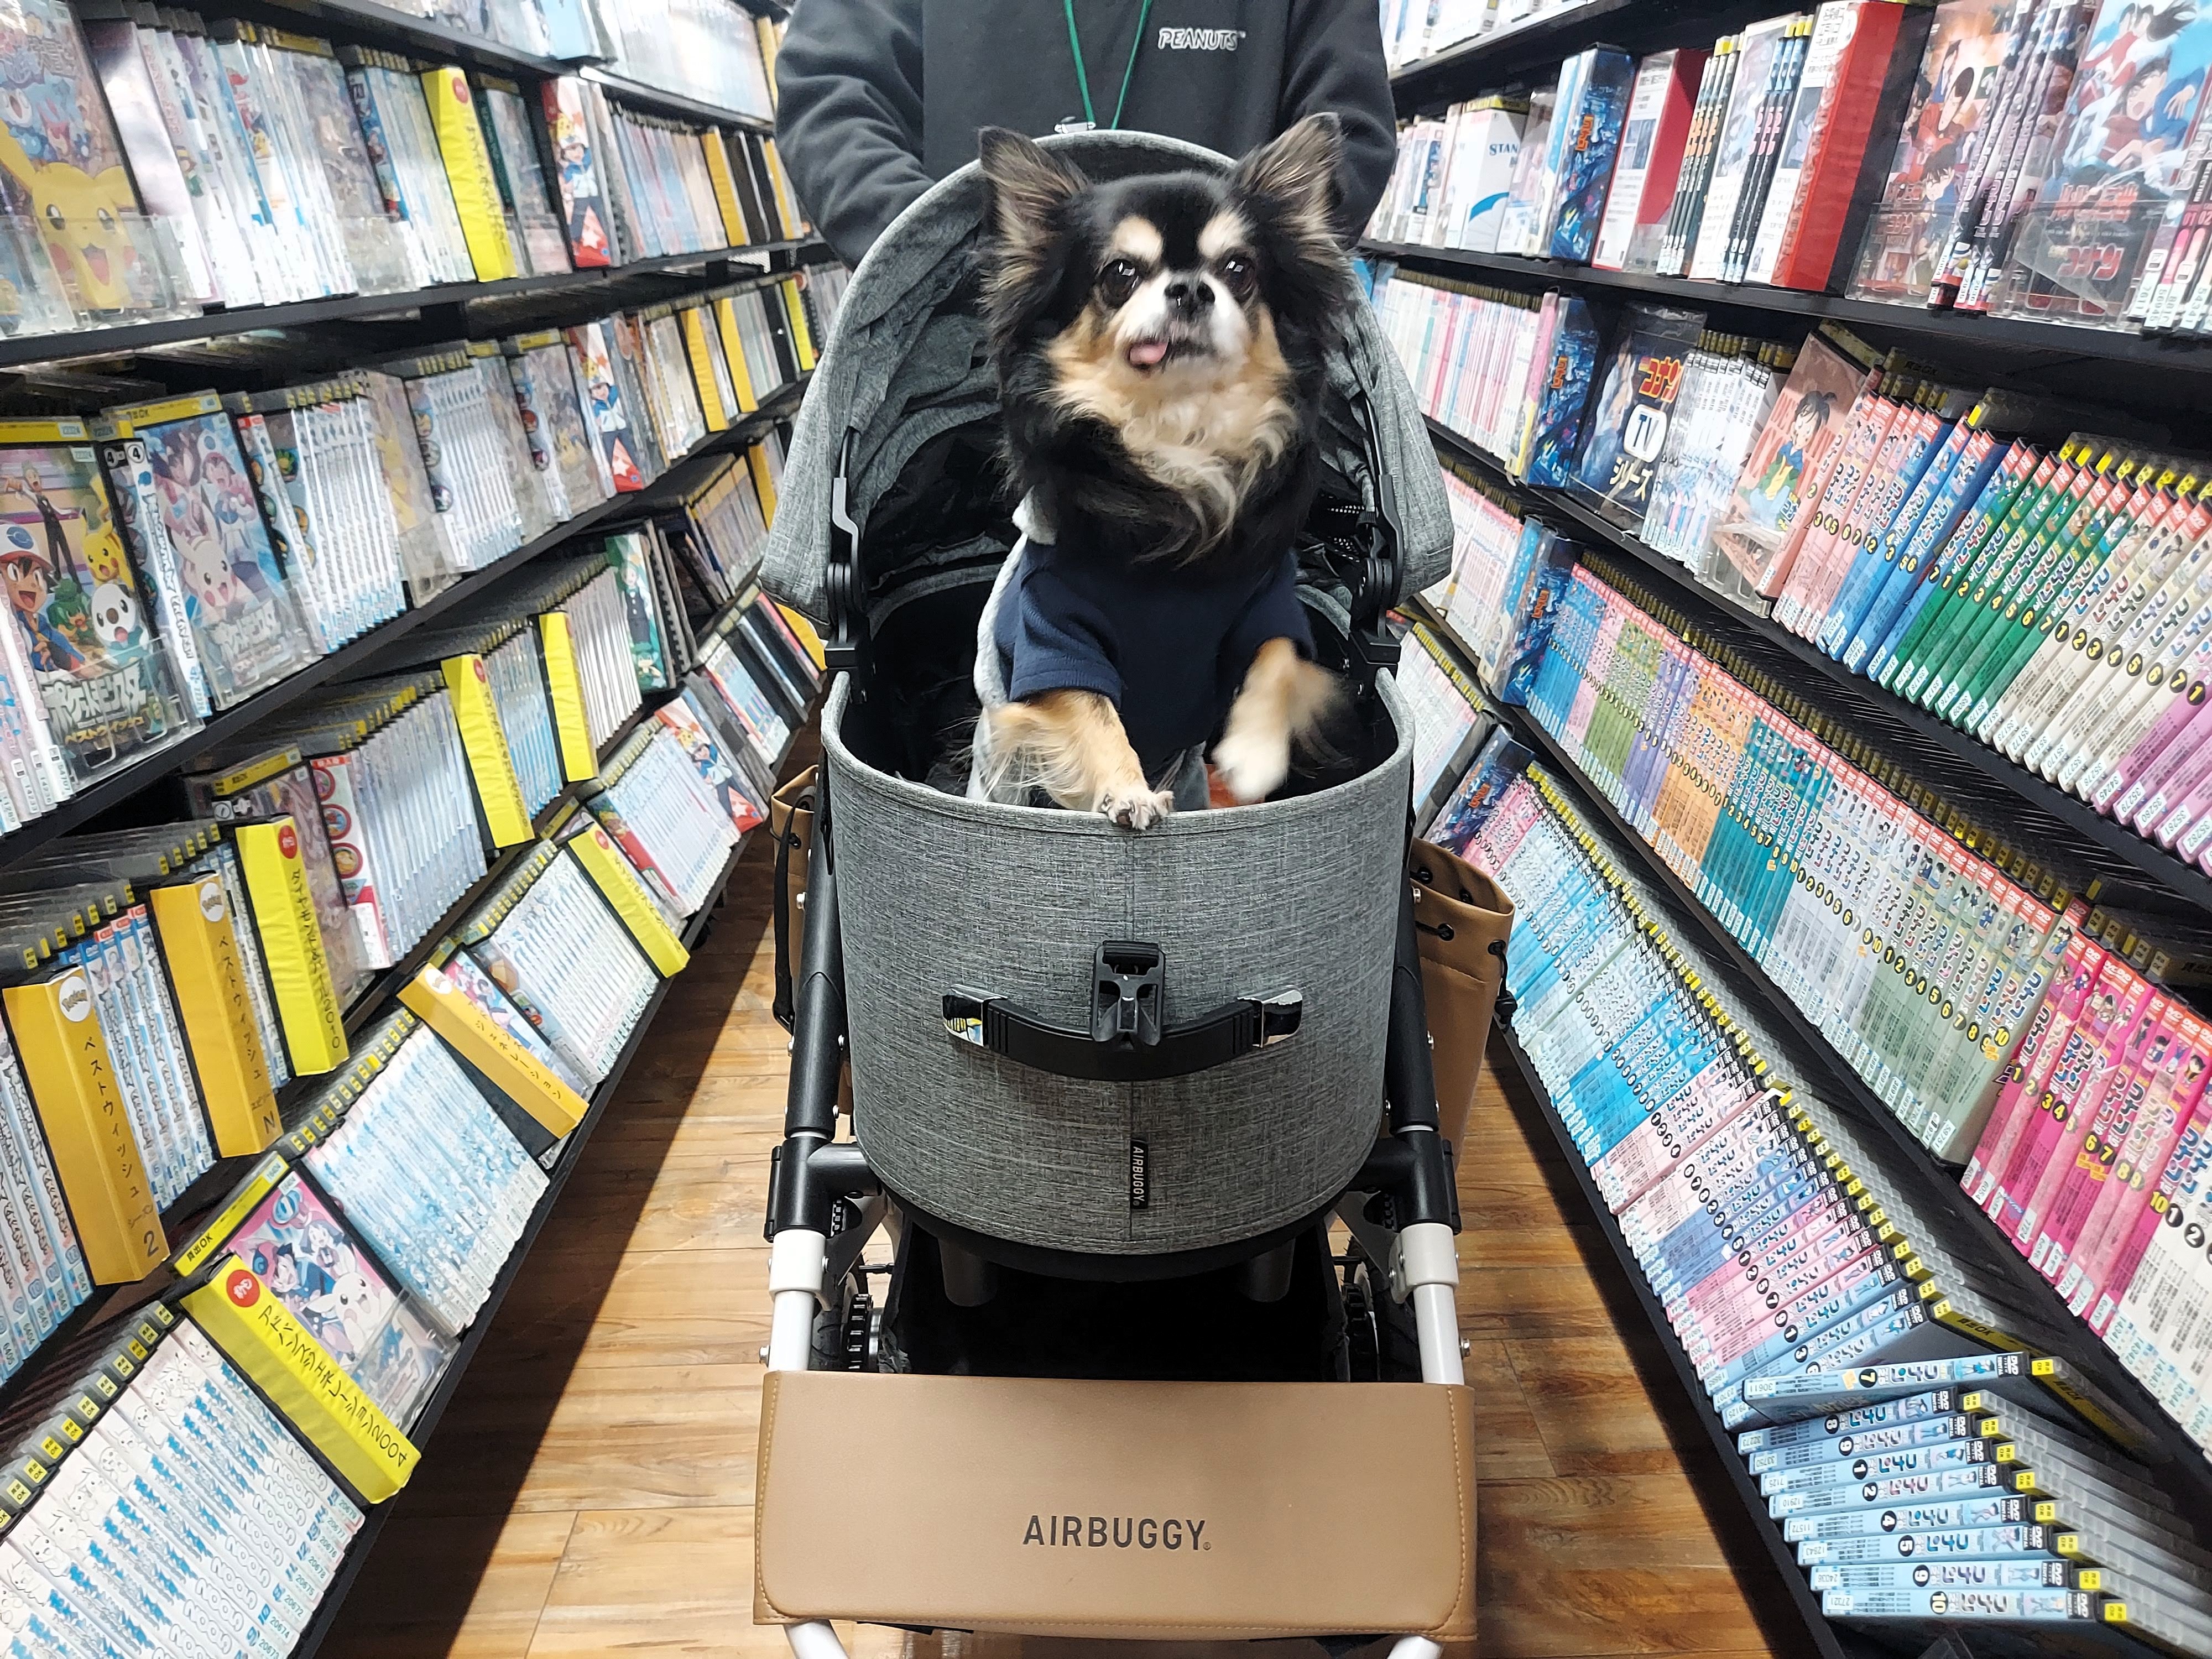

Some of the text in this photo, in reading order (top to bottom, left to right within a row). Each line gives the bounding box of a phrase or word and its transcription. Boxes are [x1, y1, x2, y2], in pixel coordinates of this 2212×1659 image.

[1158, 28, 1238, 50] PEANUTS
[1638, 356, 1684, 403] コナン
[1632, 414, 1659, 452] TV
[1609, 456, 1653, 502] シリーズ
[2074, 567, 2110, 614] コナン
[2093, 576, 2128, 623] コナン
[2107, 583, 2146, 632] コナン
[2130, 589, 2168, 639] コナン
[2150, 598, 2190, 648] コナン
[2099, 776, 2119, 800] 34245
[2121, 787, 2141, 813] 35279
[2010, 969, 2043, 1018] コナン
[1133, 1145, 1145, 1206] AIRBUGGY
[143, 1230, 159, 1258] 2
[1891, 1364, 1938, 1383] コナン
[2010, 1355, 2018, 1375] DVD
[1750, 1382, 1773, 1392] 30611
[1850, 1406, 1886, 1427] コナン
[1863, 1430, 1901, 1449] コナン
[1879, 1453, 1917, 1474] コナン
[1889, 1477, 1928, 1495] コナン
[1908, 1508, 1949, 1527] コナン
[1022, 1514, 1206, 1551] AIRBUGGY
[1926, 1533, 1969, 1552] コナン
[1942, 1566, 1986, 1584] コナン
[1961, 1594, 2007, 1614] コナン
